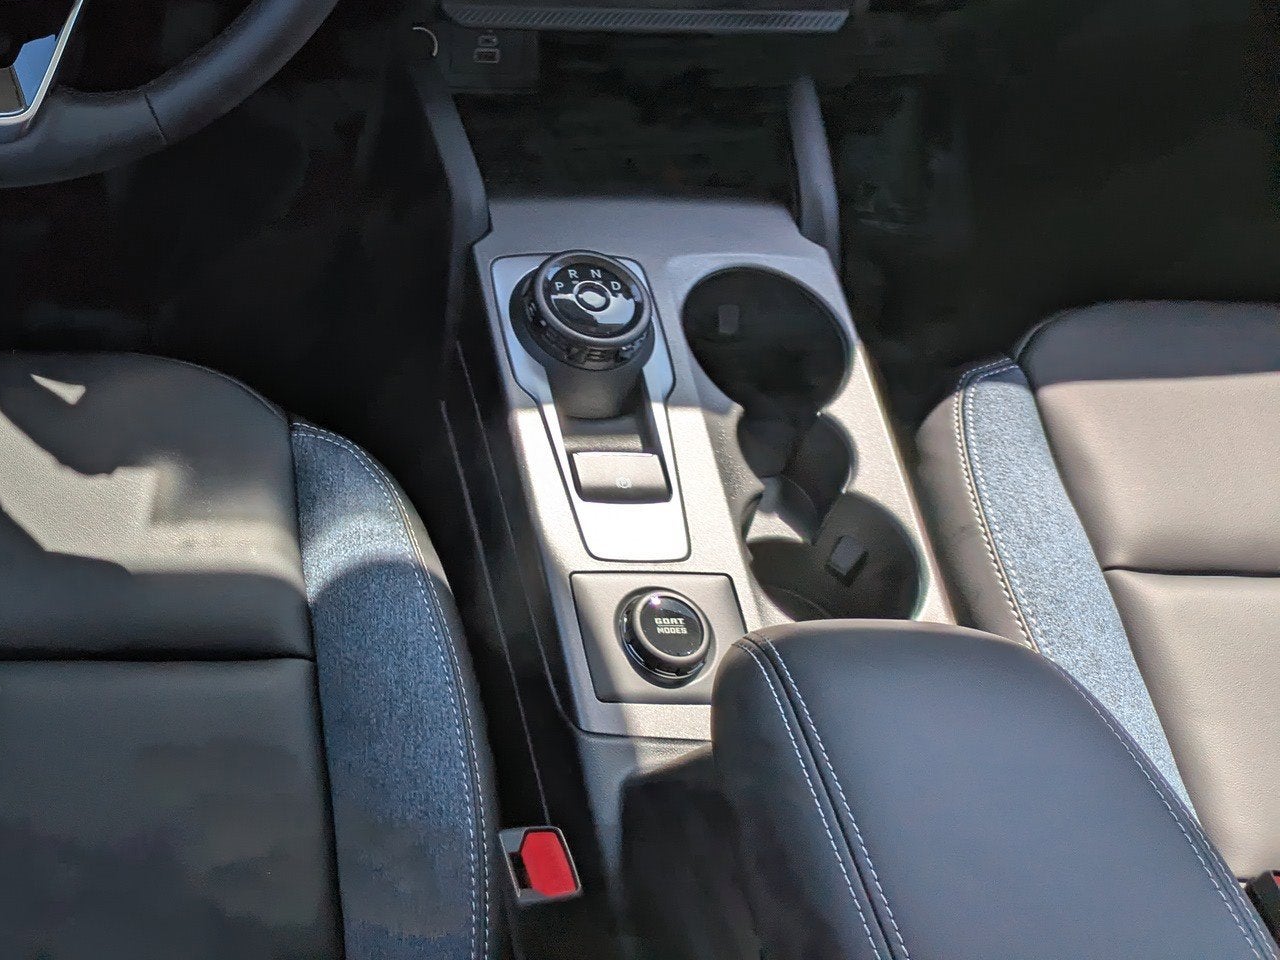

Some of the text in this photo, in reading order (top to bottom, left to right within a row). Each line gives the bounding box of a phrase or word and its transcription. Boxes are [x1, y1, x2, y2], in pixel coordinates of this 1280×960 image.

[555, 269, 621, 291] P R N D
